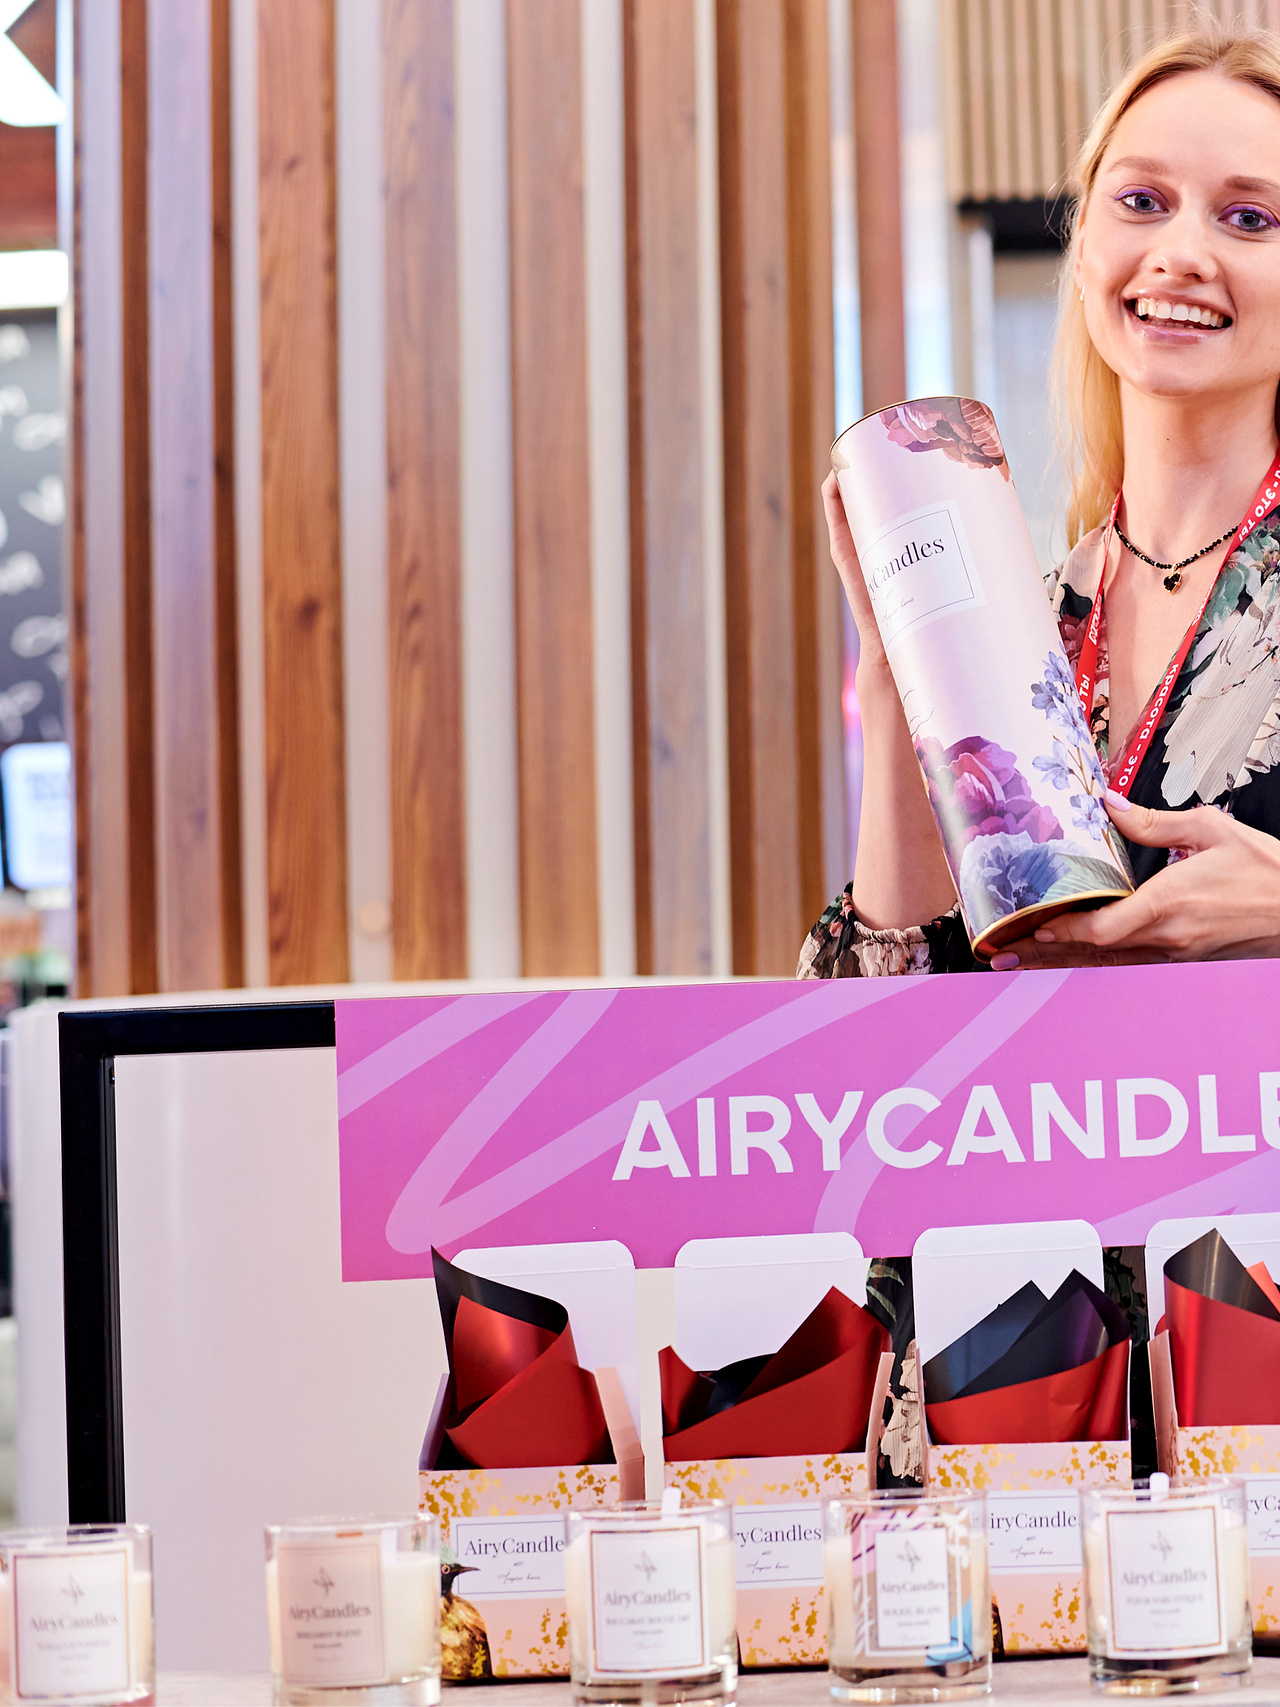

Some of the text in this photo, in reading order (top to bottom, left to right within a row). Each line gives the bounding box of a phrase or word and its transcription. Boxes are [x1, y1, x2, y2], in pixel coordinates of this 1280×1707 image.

[868, 538, 945, 600] yCandles
[990, 1511, 1080, 1532] iryCandle
[464, 1535, 565, 1558] AiryCandle
[880, 1579, 947, 1596] AiryCandles
[1121, 1567, 1208, 1588] AiryCandles
[604, 1587, 692, 1608] AiryCandles
[289, 1602, 371, 1621] AiryCandles
